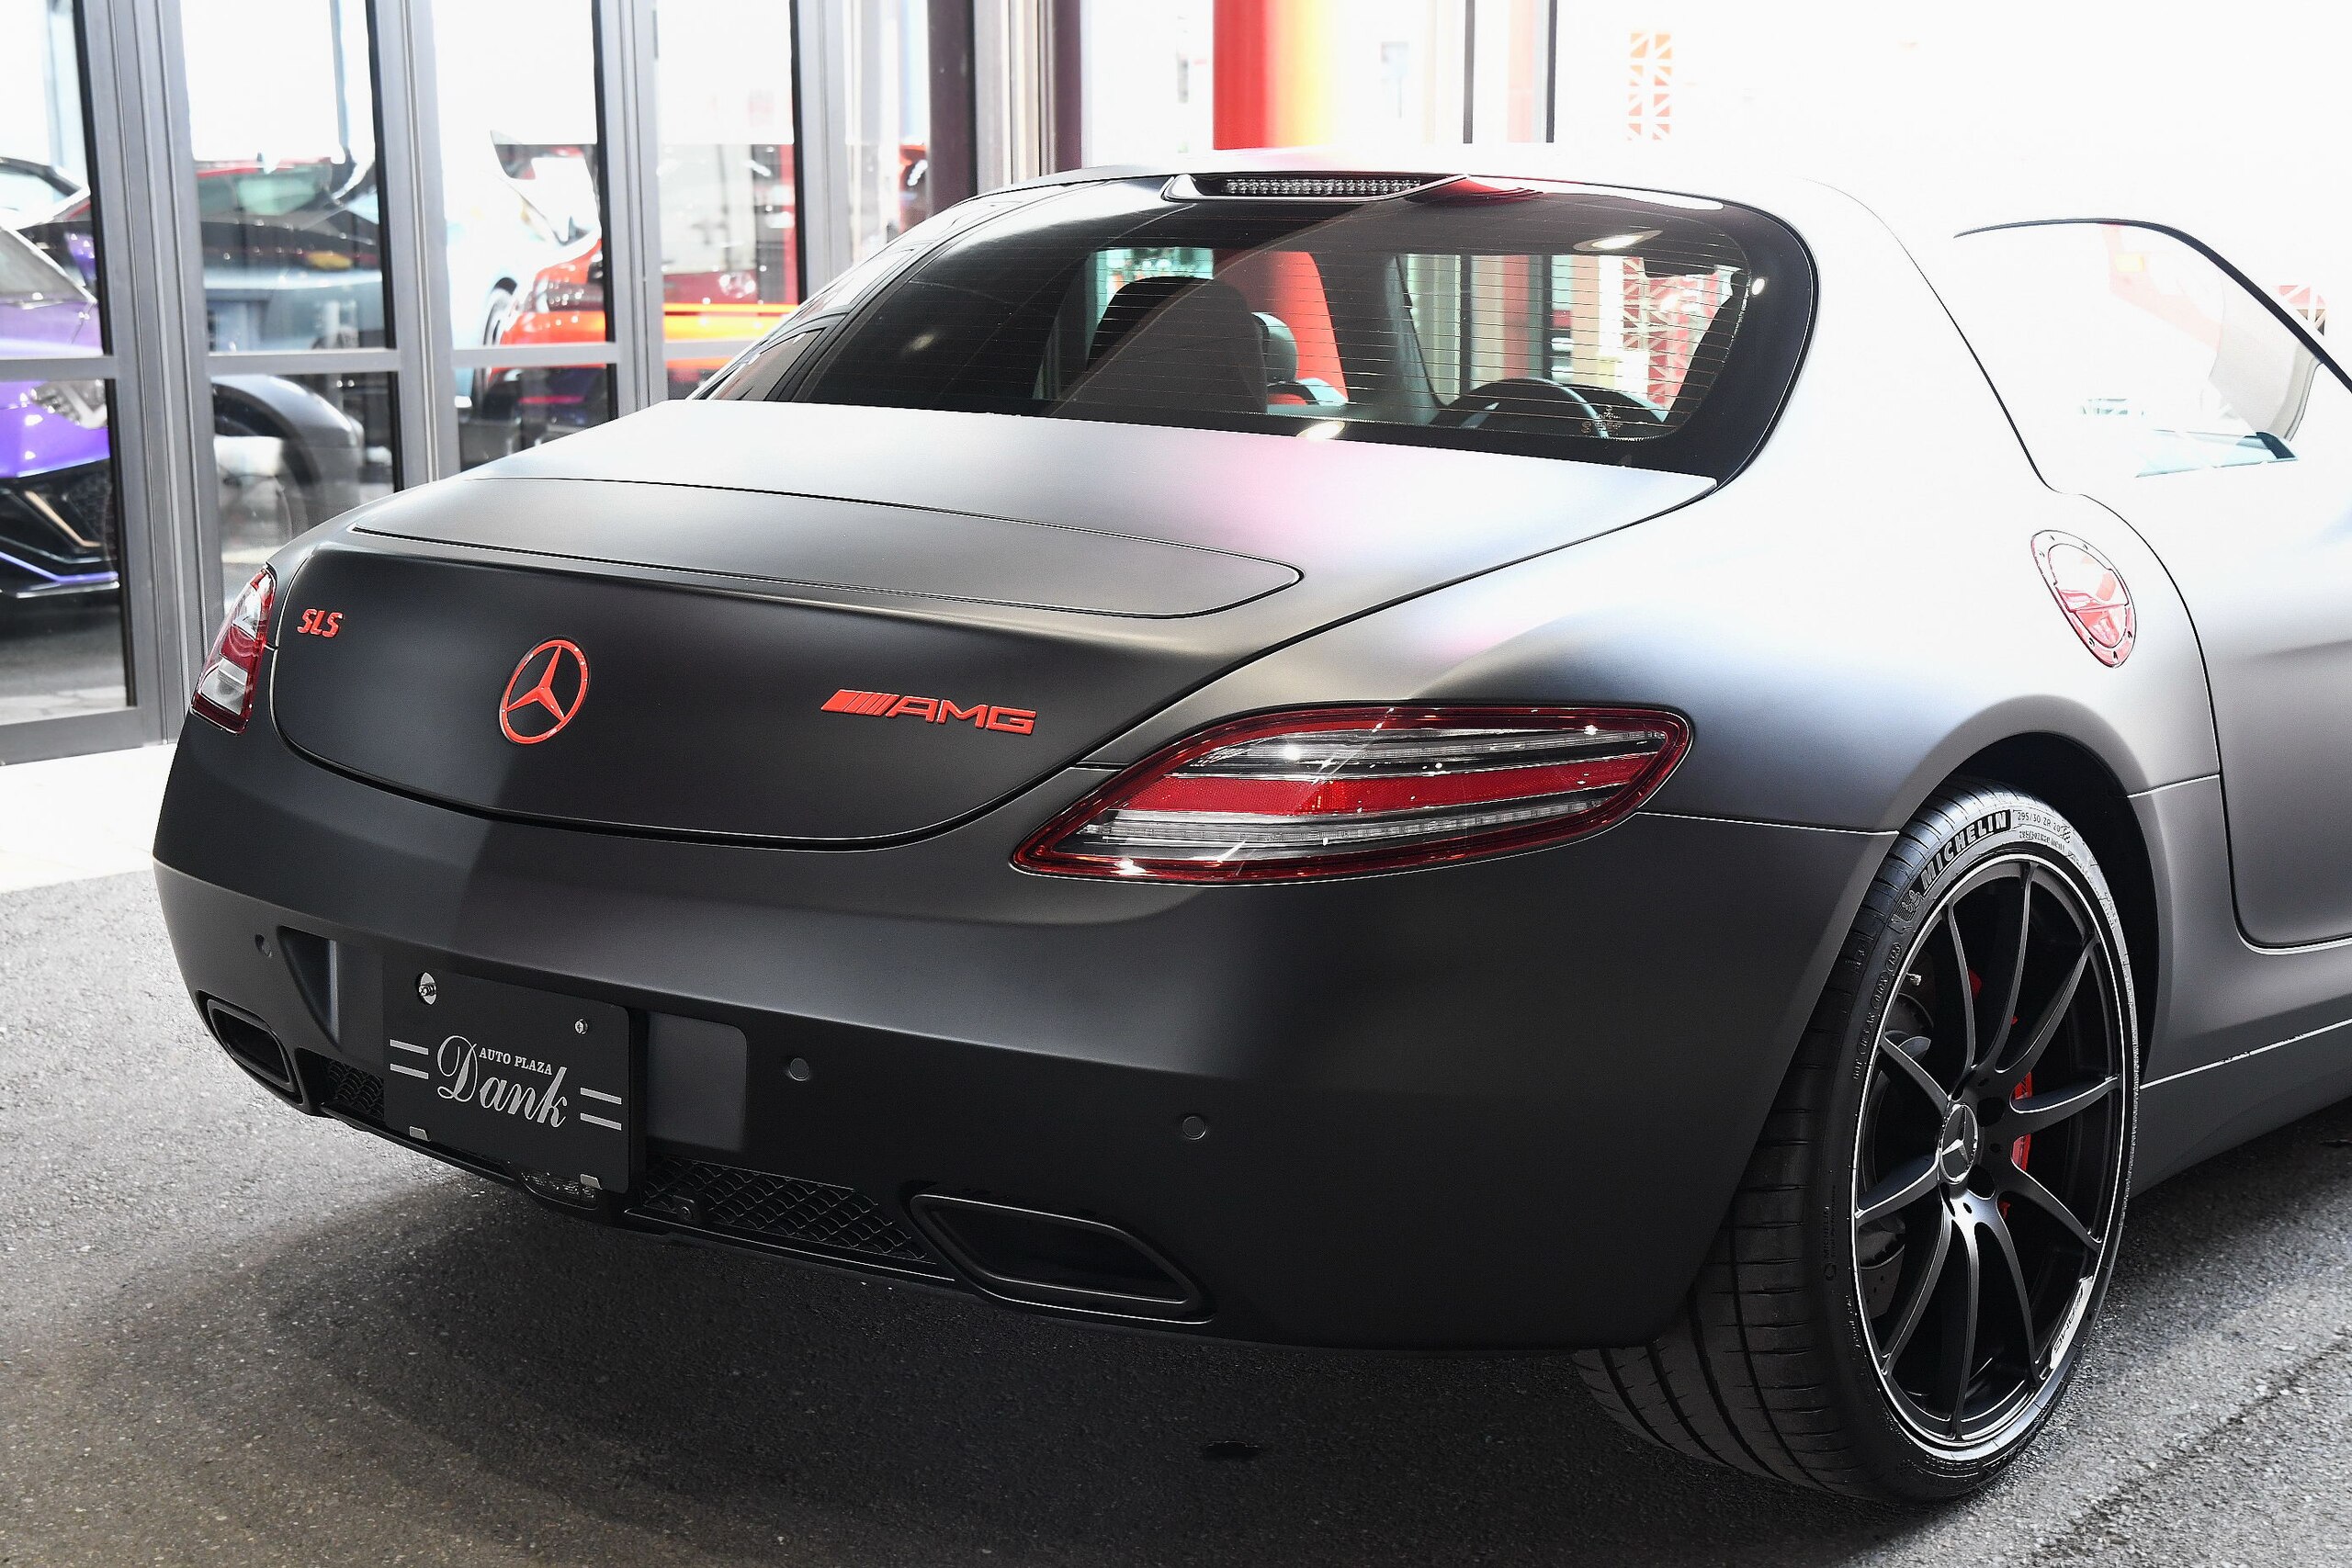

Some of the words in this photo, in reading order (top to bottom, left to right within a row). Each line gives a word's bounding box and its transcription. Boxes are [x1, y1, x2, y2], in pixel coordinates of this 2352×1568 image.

[297, 608, 344, 638] SLS
[885, 695, 1037, 735] AMG
[1920, 811, 2007, 890] MICHELIN
[436, 1035, 568, 1128] Dank
[479, 1047, 511, 1065] AUTO
[514, 1055, 553, 1076] PLAZA
